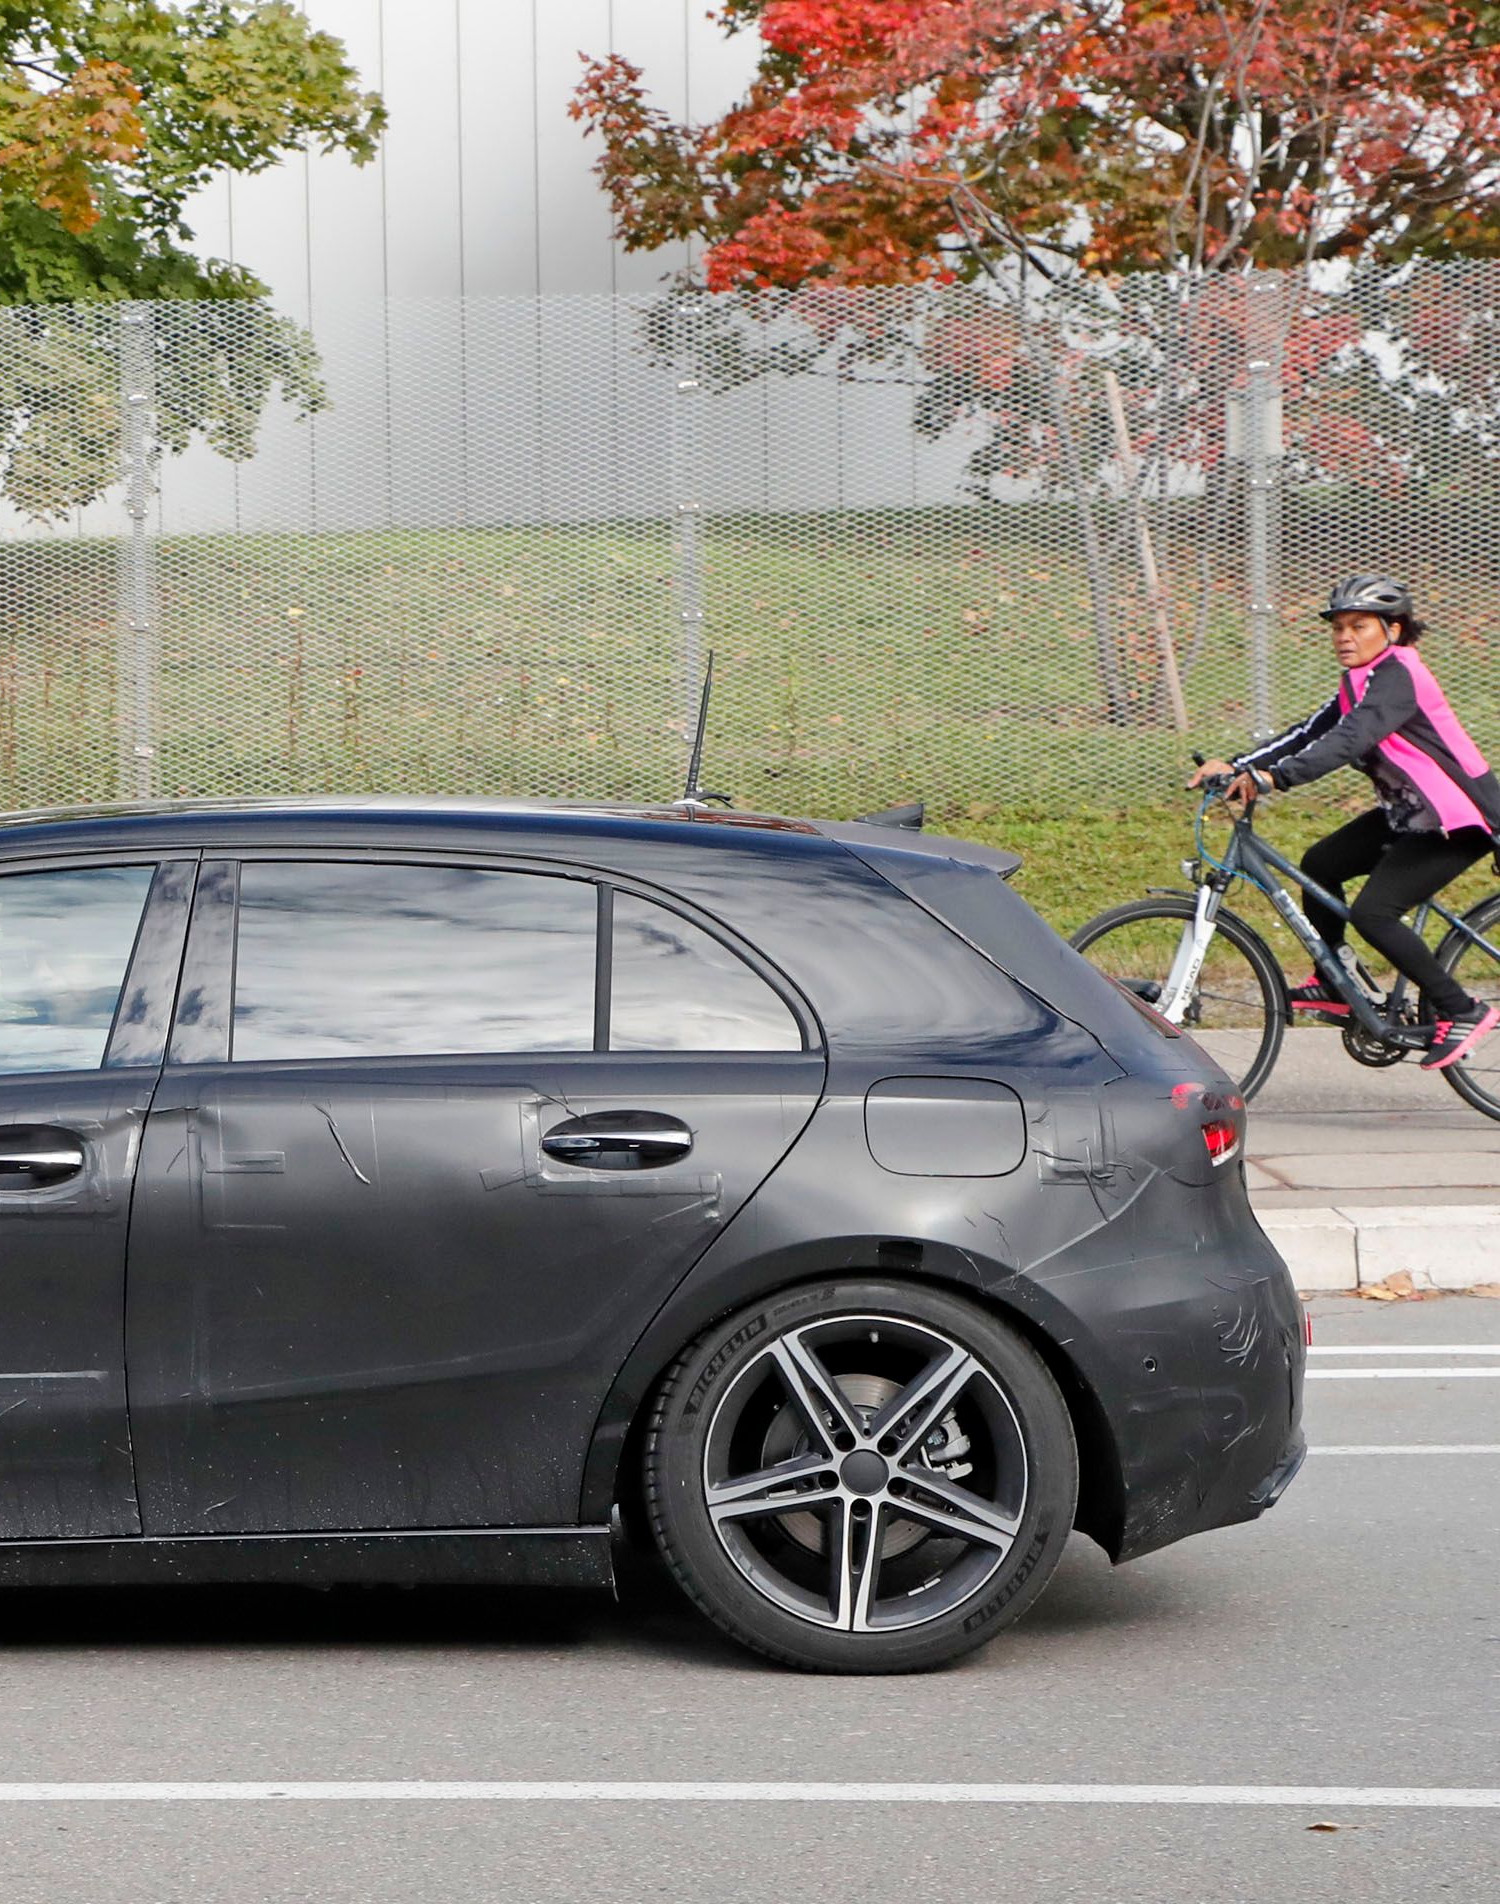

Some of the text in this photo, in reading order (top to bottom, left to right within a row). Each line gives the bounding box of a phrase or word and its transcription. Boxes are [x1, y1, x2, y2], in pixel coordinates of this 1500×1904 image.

[1181, 958, 1200, 1000] HEAD
[687, 1315, 767, 1408] MICHELIN
[967, 1537, 1046, 1631] MICHELIN
